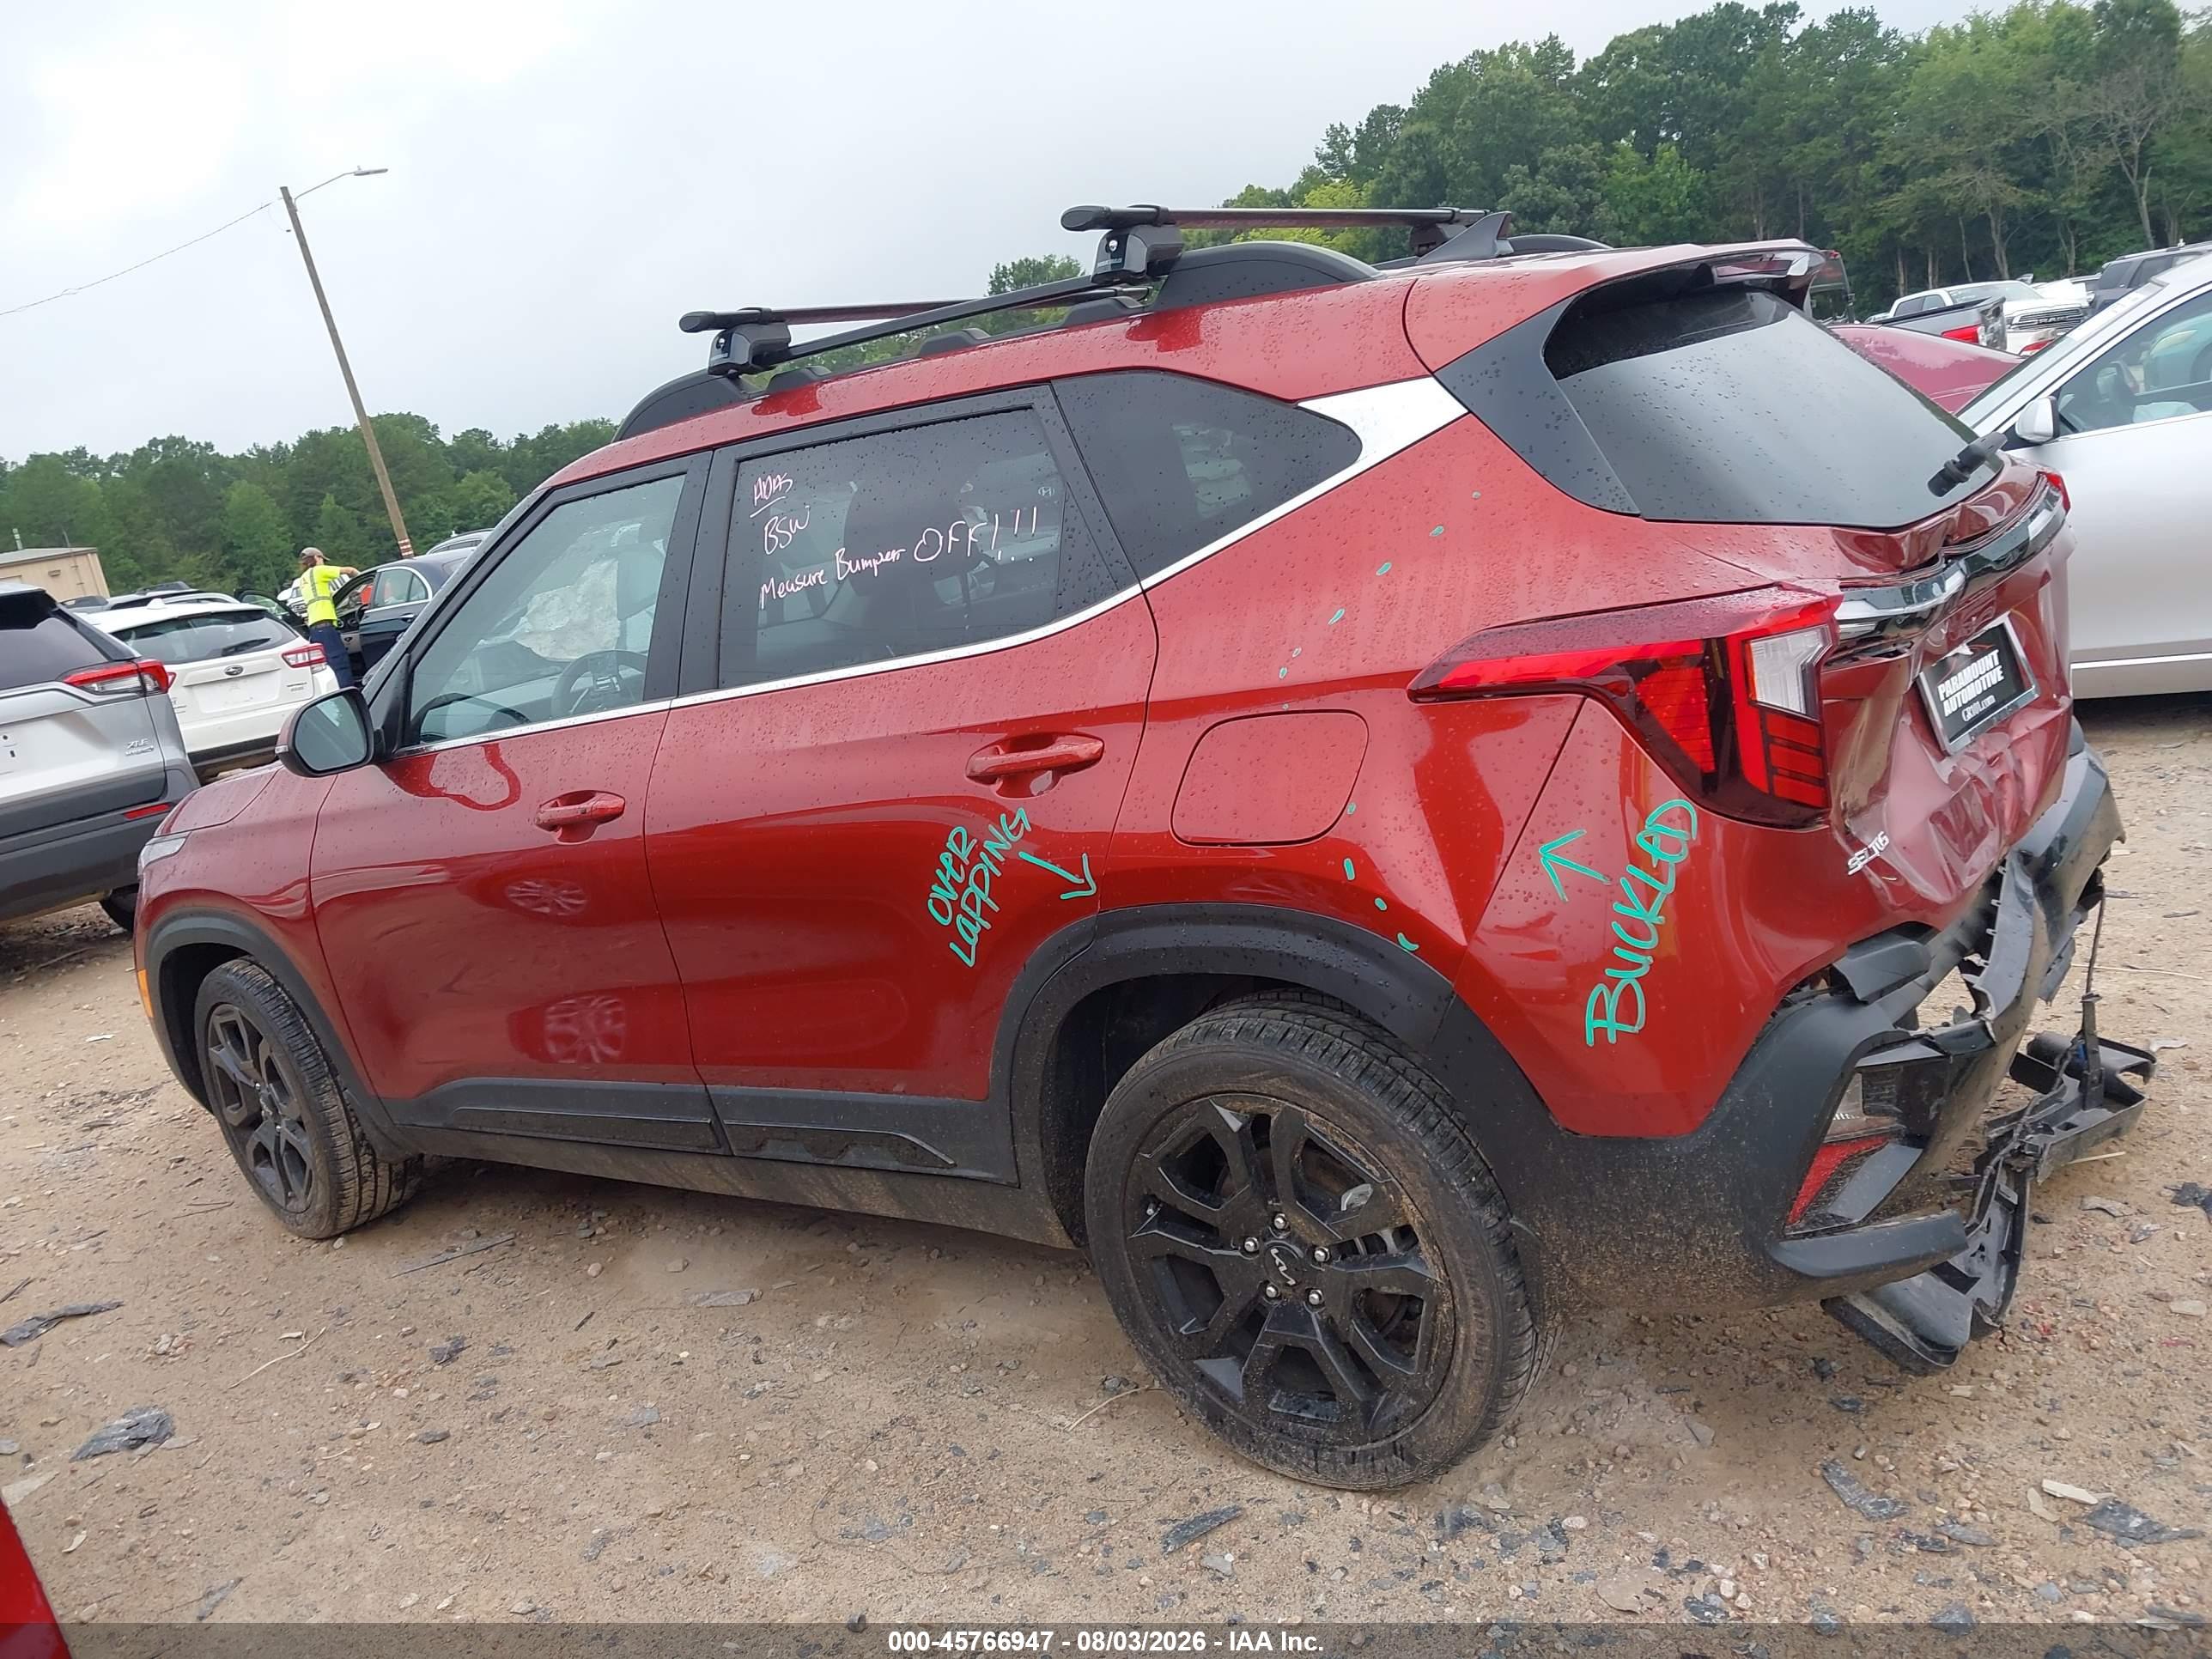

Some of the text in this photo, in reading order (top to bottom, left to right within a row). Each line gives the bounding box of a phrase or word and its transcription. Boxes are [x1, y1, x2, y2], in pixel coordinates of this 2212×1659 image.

[764, 505, 810, 555] BSW
[761, 569, 828, 610] Measure
[835, 547, 907, 580] Bumper
[1937, 648, 2000, 702] PARAMOUNT
[1942, 665, 2005, 717] AUTOMOTIVE
